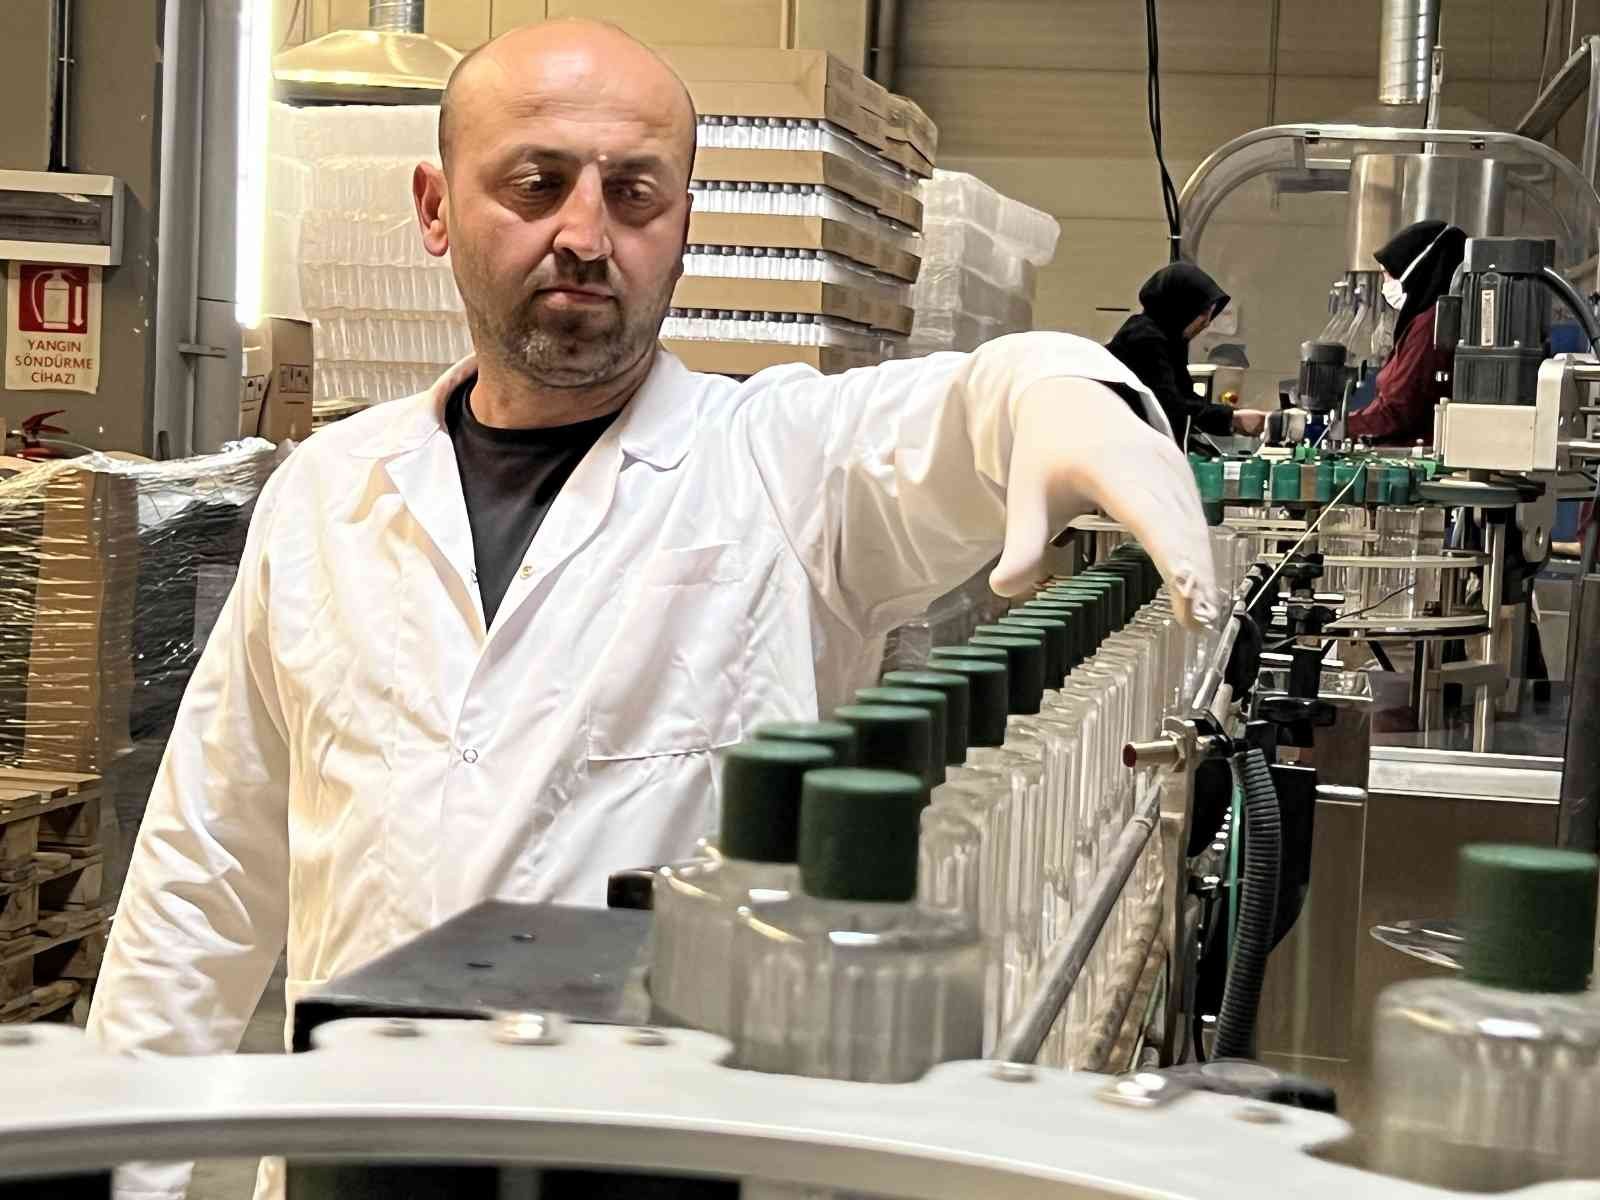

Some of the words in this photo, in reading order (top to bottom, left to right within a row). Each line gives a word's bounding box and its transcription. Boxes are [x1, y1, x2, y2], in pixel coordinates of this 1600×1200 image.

[27, 339, 82, 353] YANGIN
[15, 352, 94, 370] SÖNDÜRME
[31, 370, 76, 385] CİHAZI
